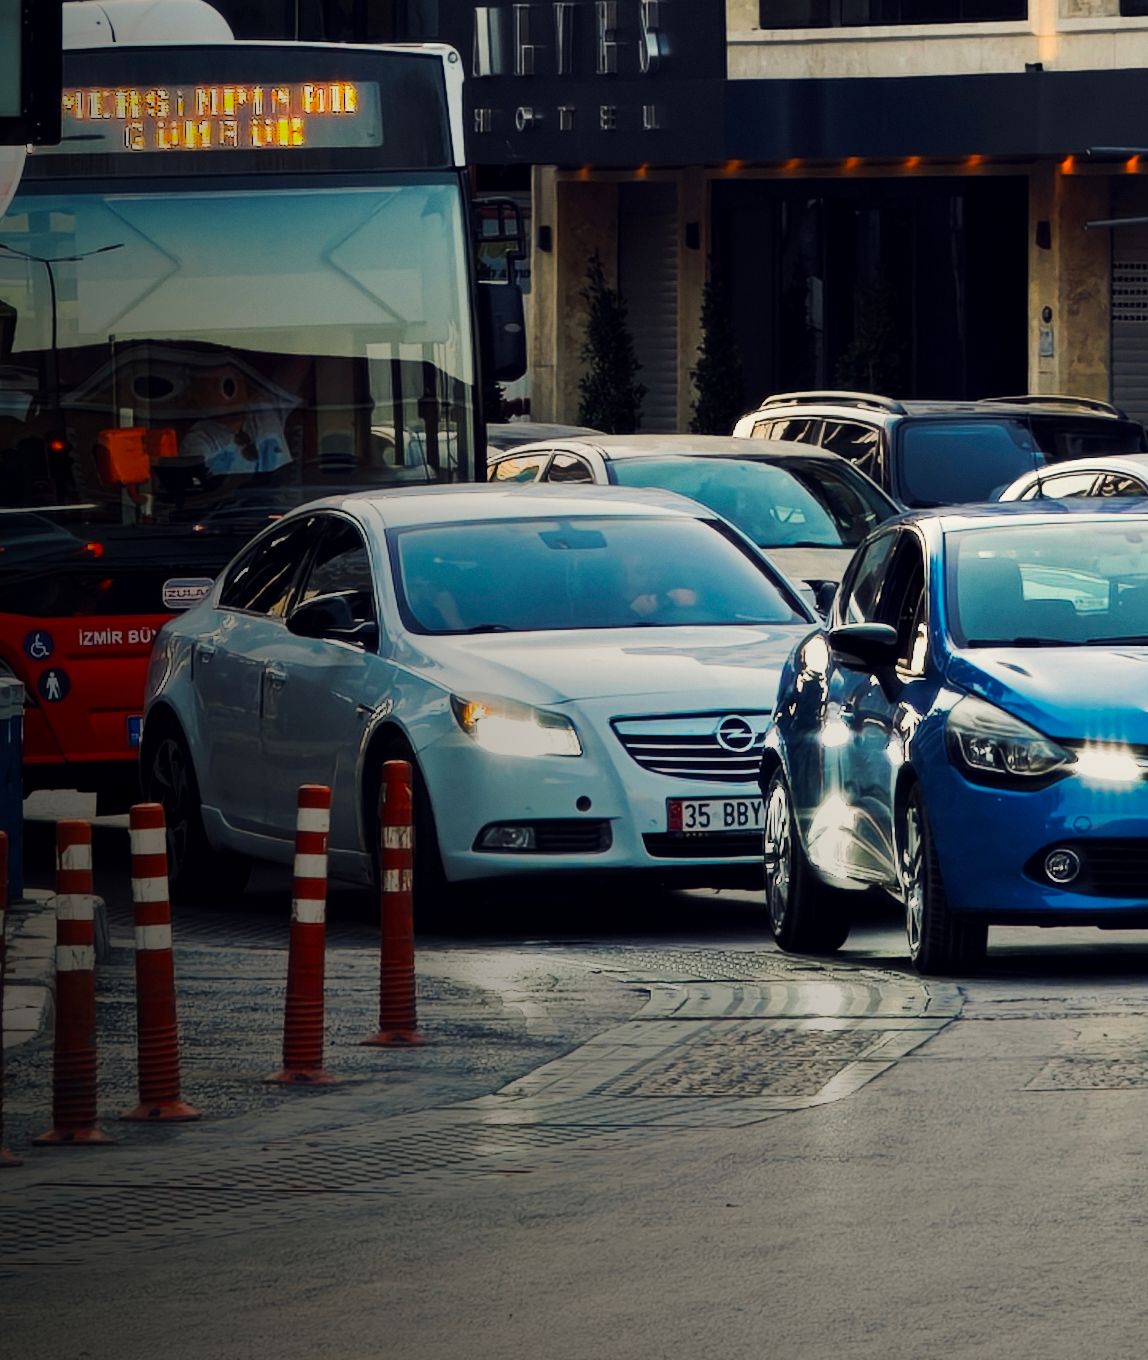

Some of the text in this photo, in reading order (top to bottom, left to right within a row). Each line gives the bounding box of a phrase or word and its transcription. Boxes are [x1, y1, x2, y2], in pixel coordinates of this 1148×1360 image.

[77, 626, 123, 647] İZMİR
[684, 801, 762, 829] 35 BBY
